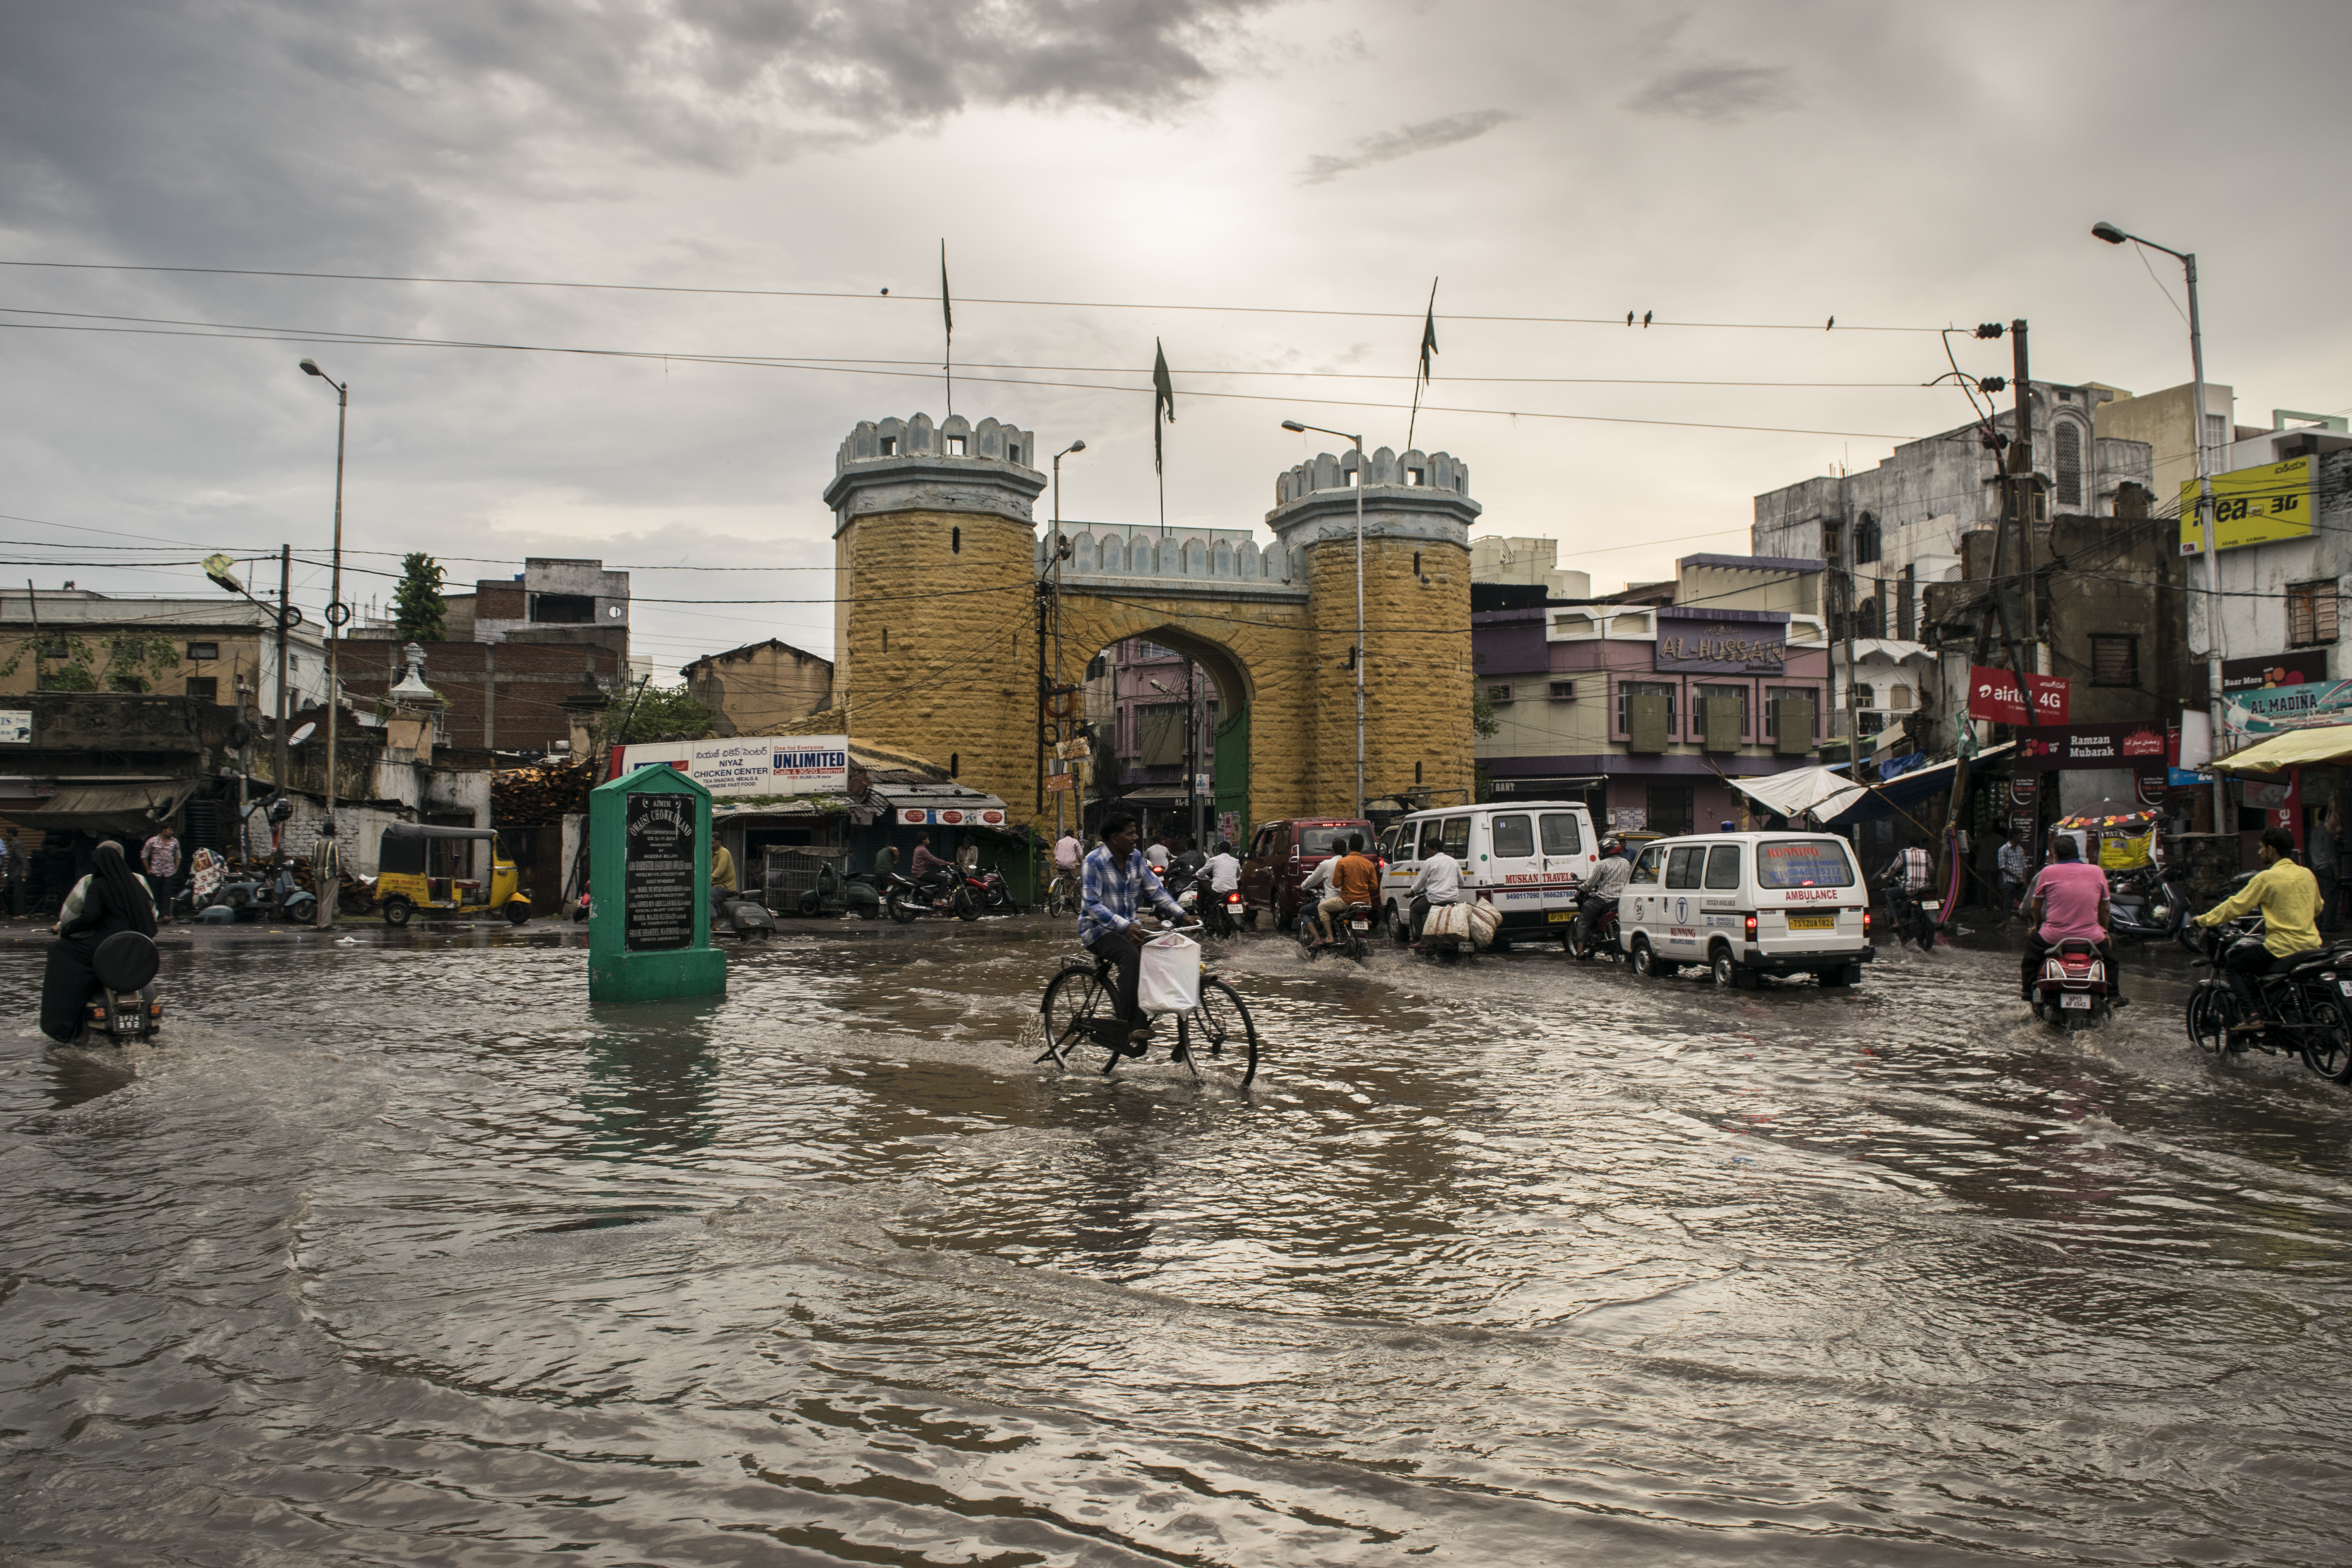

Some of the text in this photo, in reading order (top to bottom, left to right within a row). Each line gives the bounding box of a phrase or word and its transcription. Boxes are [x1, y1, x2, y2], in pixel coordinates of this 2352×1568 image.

[1659, 637, 1786, 664] AL-HUSSAIN
[2040, 692, 2060, 708] 4G
[2251, 700, 2265, 714] AL
[2269, 694, 2318, 713] MADINA
[2071, 736, 2110, 745] Ramzan
[2069, 747, 2114, 757] Mubarak
[719, 759, 743, 767] NIYAZ
[773, 752, 845, 769] UNLIMITED
[694, 767, 768, 778] CHICKEN CENTER
[630, 813, 650, 836] OWAISI
[651, 809, 673, 821] CHOWK
[1768, 847, 1820, 858] RUNNING
[1505, 873, 1574, 884] MUSKAN TRAVELS
[1786, 890, 1838, 901] AMBULANCE
[1670, 927, 1695, 937] RUNNING
